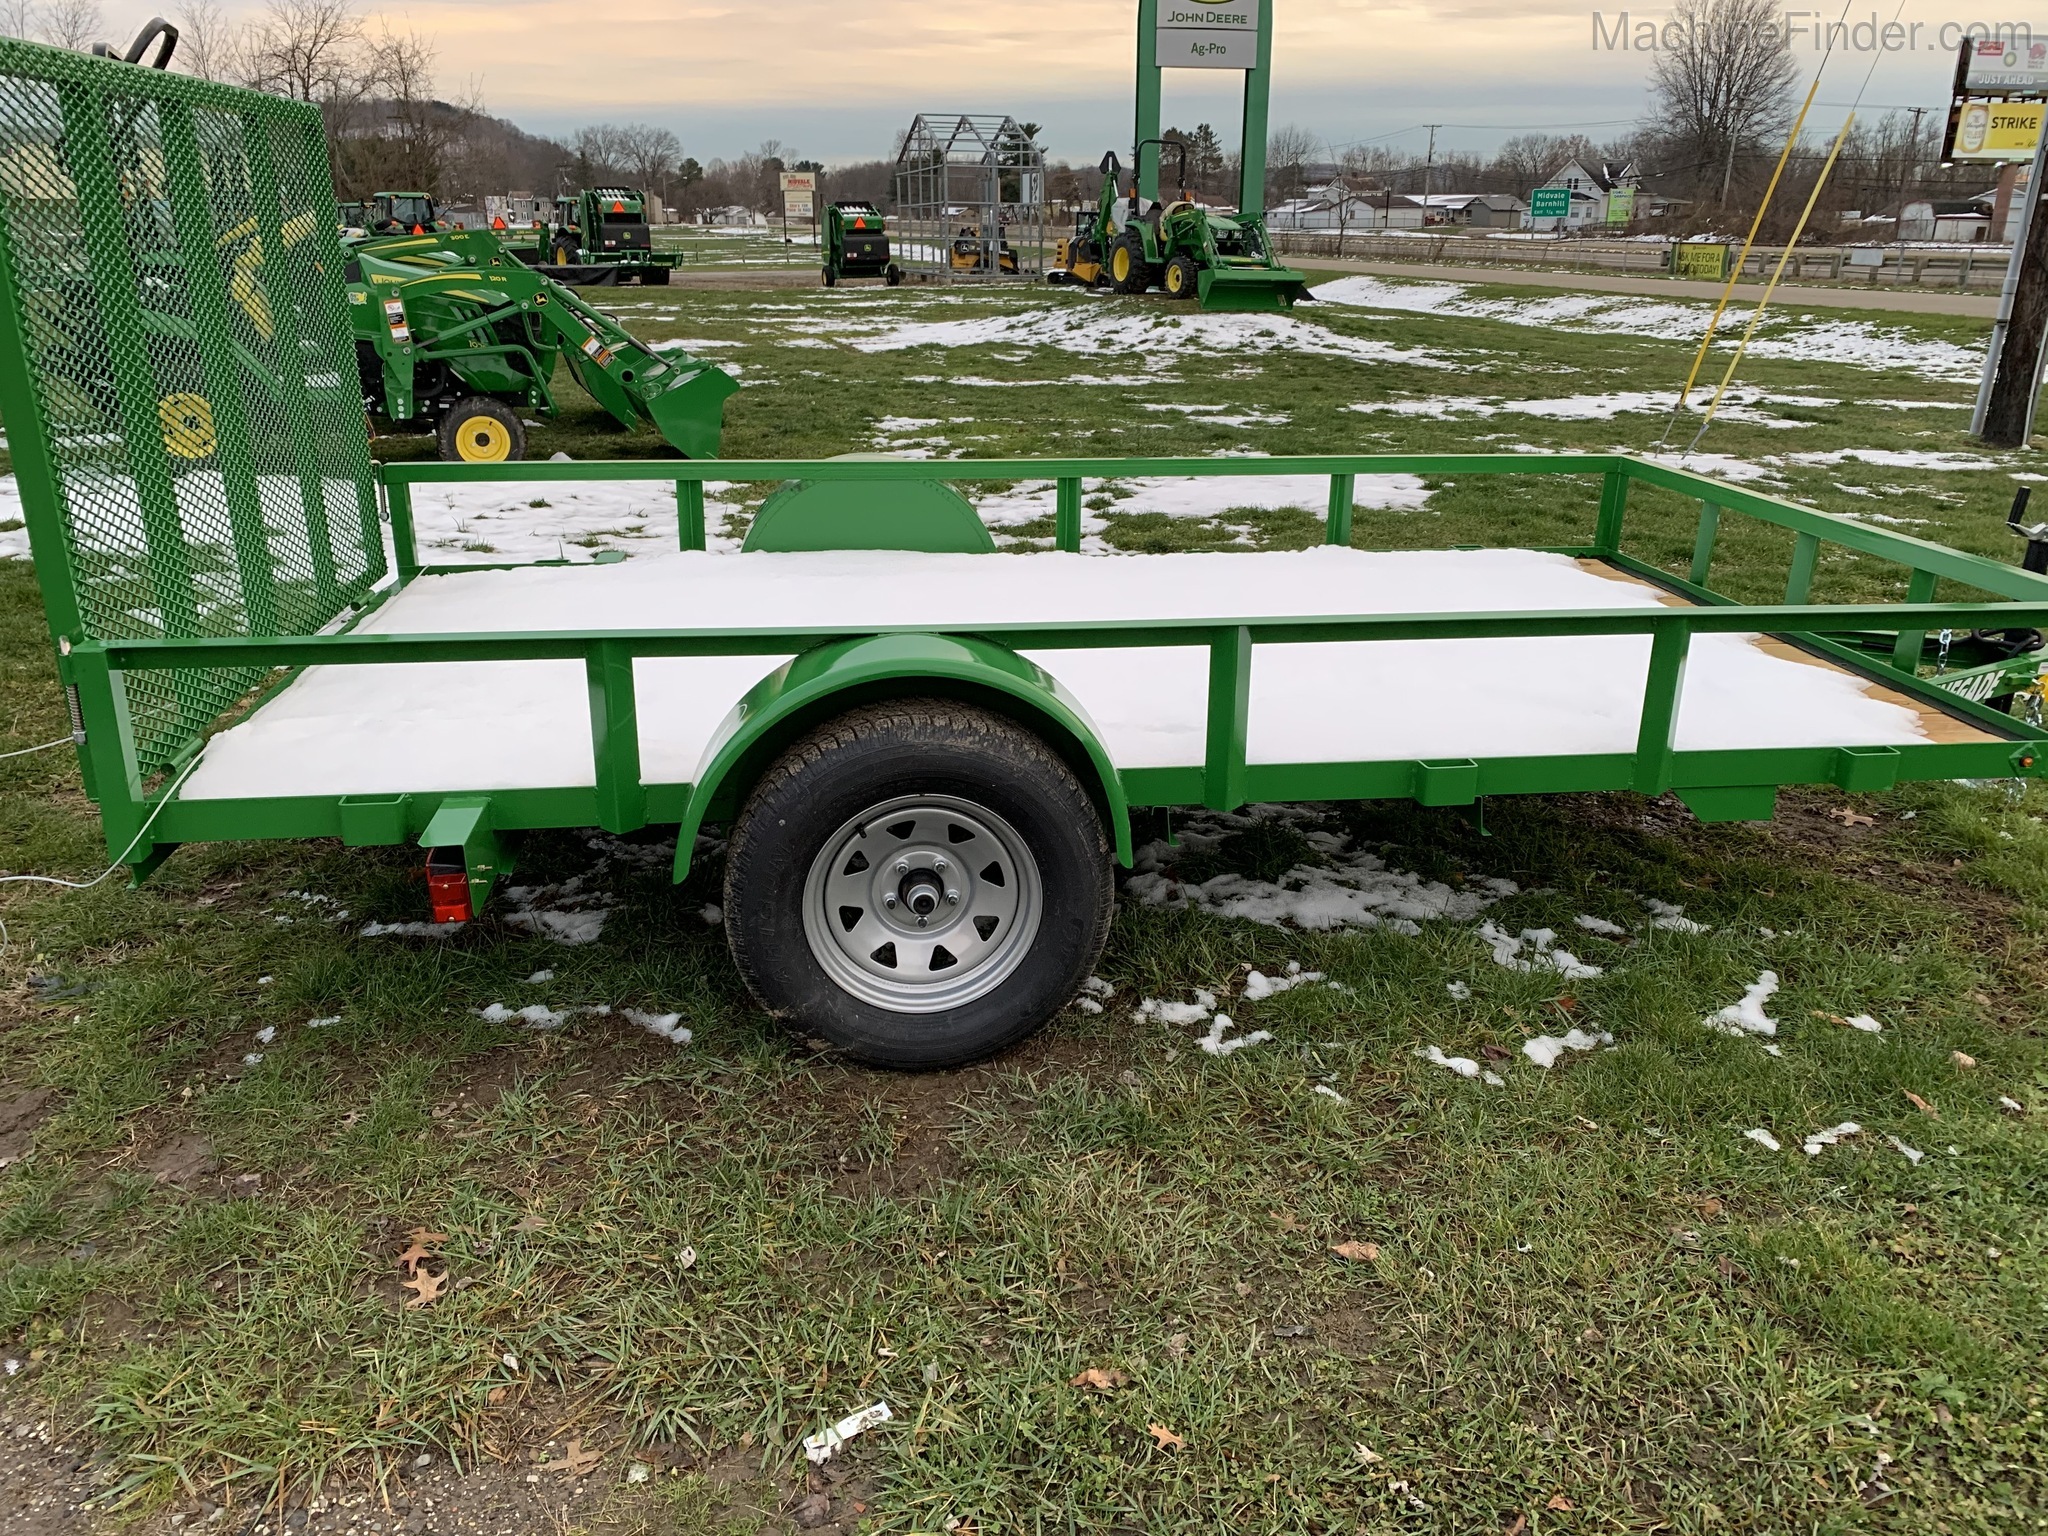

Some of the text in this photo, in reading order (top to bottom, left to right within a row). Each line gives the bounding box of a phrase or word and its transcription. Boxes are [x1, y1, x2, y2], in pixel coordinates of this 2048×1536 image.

[1167, 10, 1248, 24] JOHN DEERE
[1191, 42, 1227, 56] Ag-Pro
[1978, 74, 2034, 85] JUST AHEAD
[1991, 116, 2038, 129] STRIKE
[1702, 252, 1715, 263] FOR
[1715, 253, 1720, 262] A
